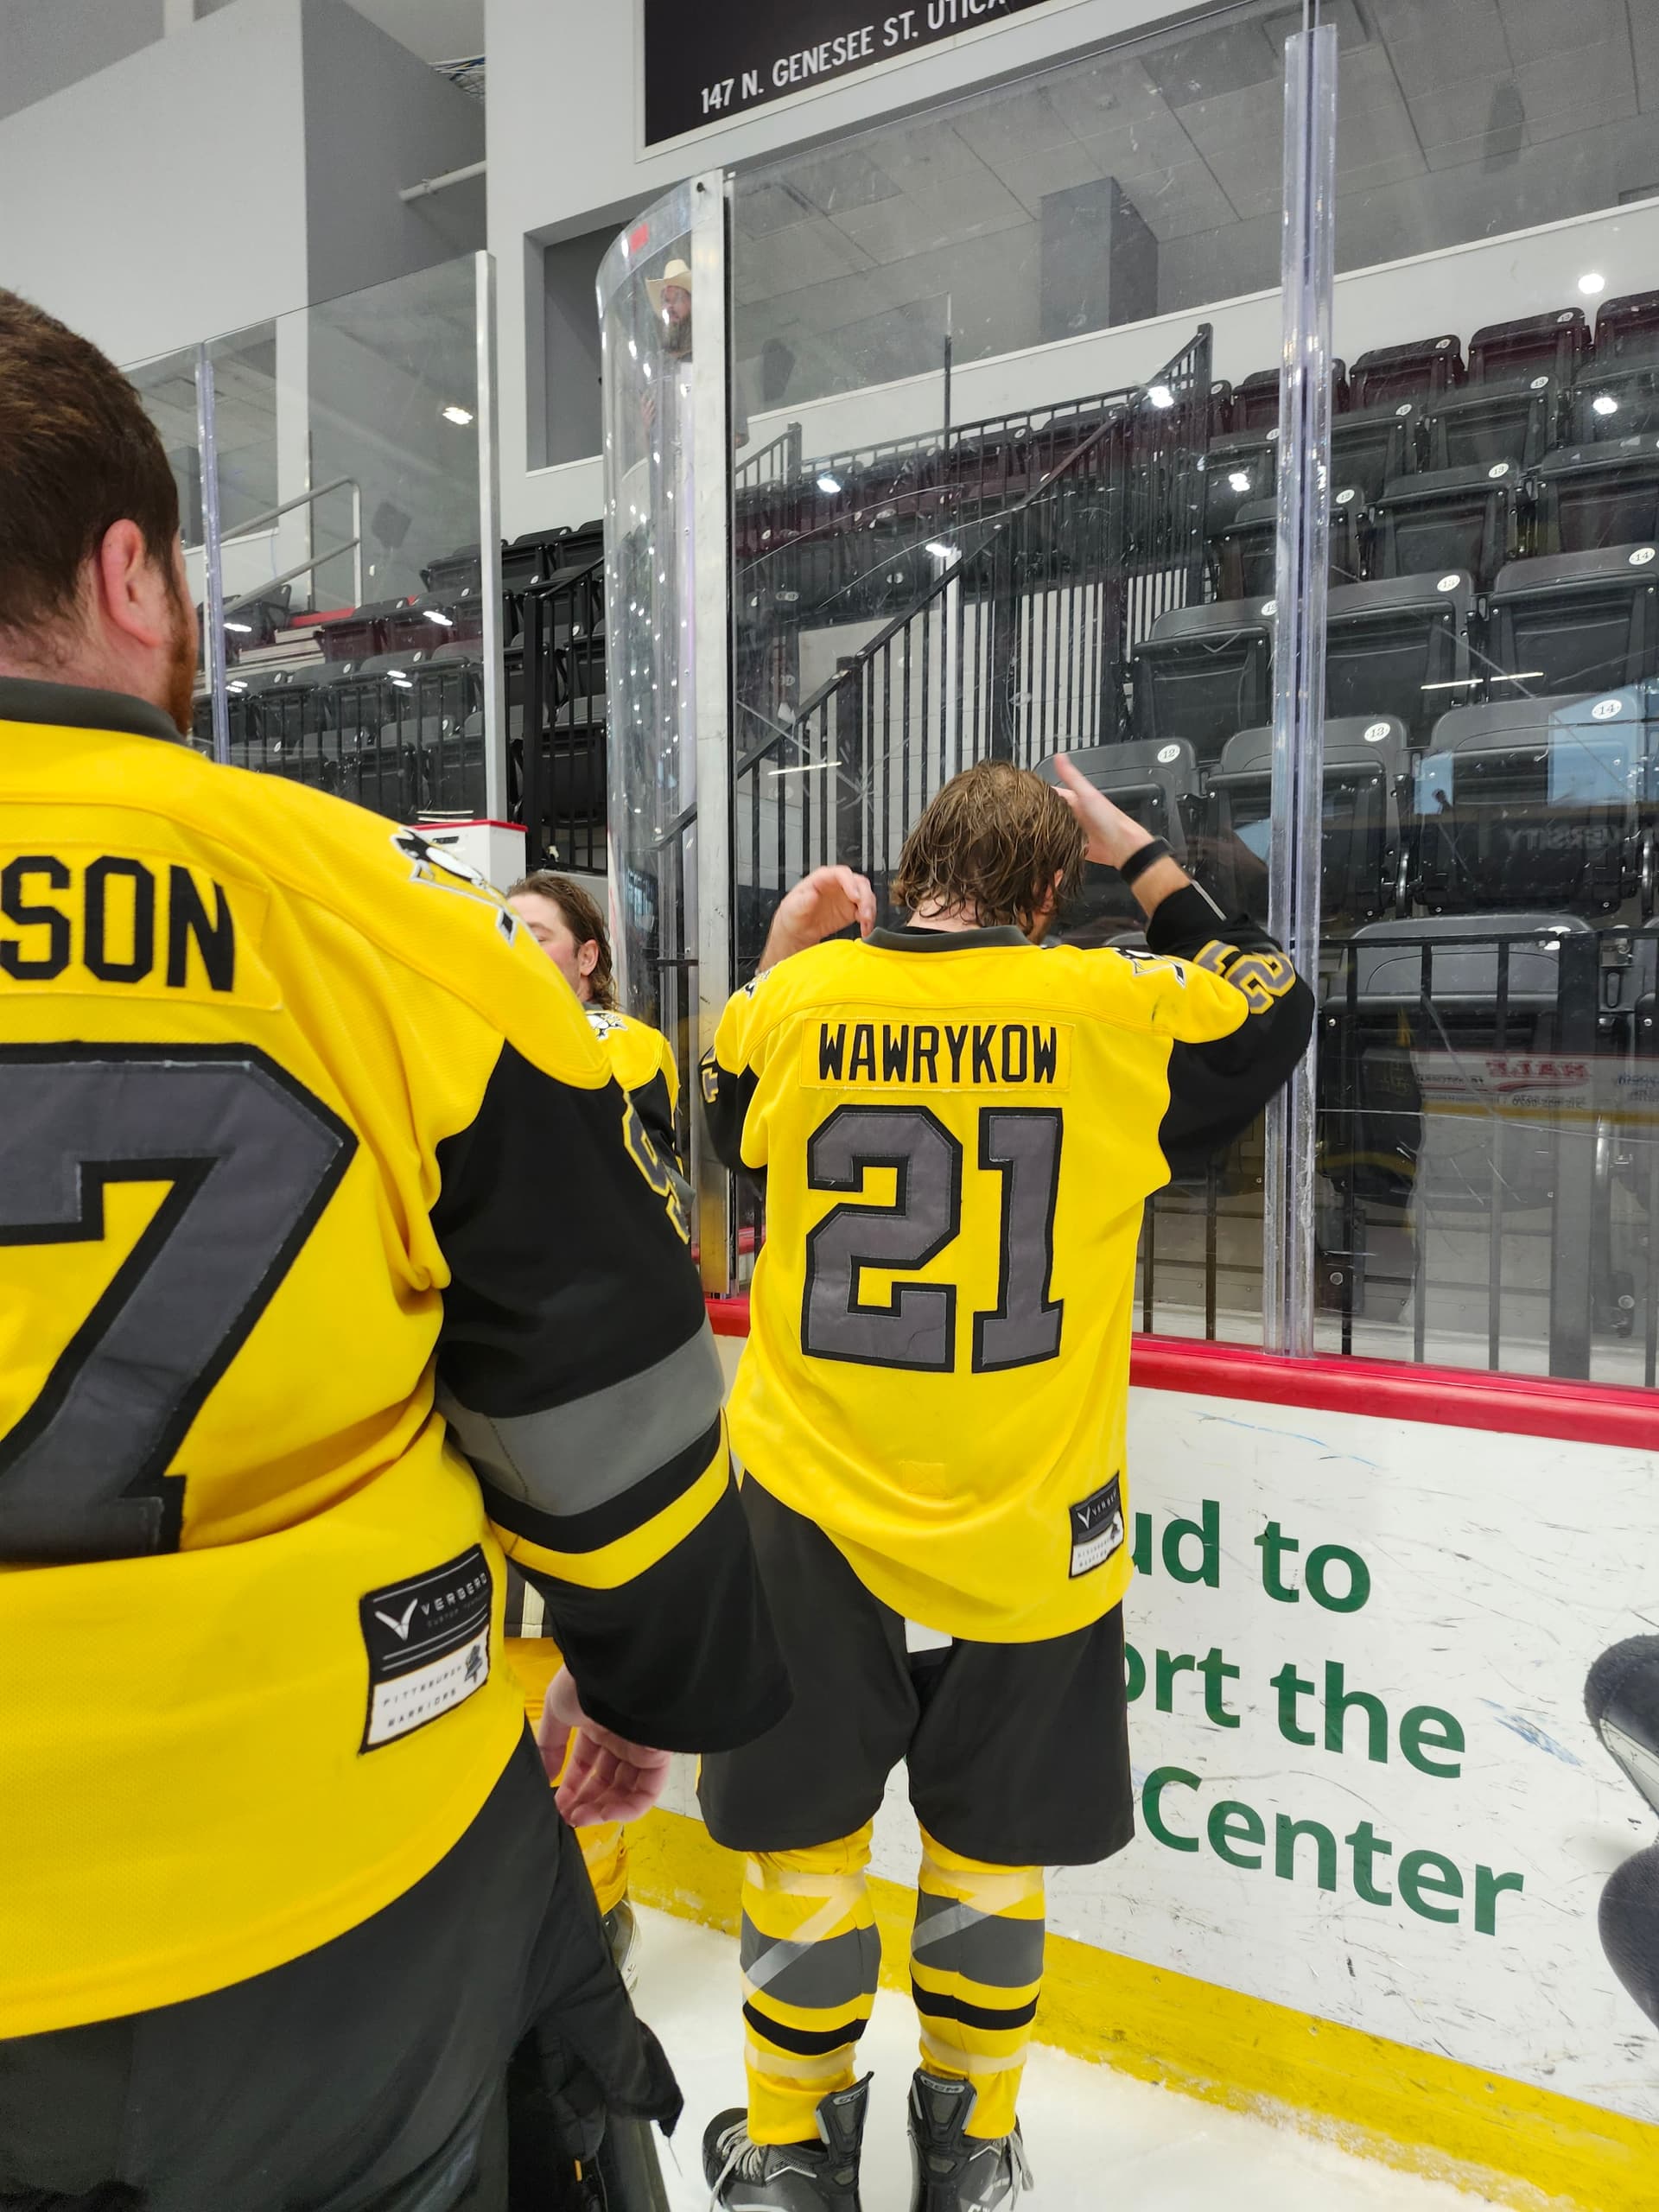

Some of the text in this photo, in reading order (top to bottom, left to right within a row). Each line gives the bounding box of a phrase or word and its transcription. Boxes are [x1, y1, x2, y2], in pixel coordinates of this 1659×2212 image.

[701, 0, 1006, 114] 147 N. GENESEE ST. UTI
[0, 855, 236, 992] SON
[819, 1023, 1057, 1084] WAWRYKOW
[802, 1104, 1064, 1374] 21
[0, 1039, 359, 1562] 7
[1254, 1521, 1371, 1613] to
[1269, 1660, 1465, 1778] the
[1141, 1766, 1524, 1936] Center
[923, 2079, 960, 2092] CCM
